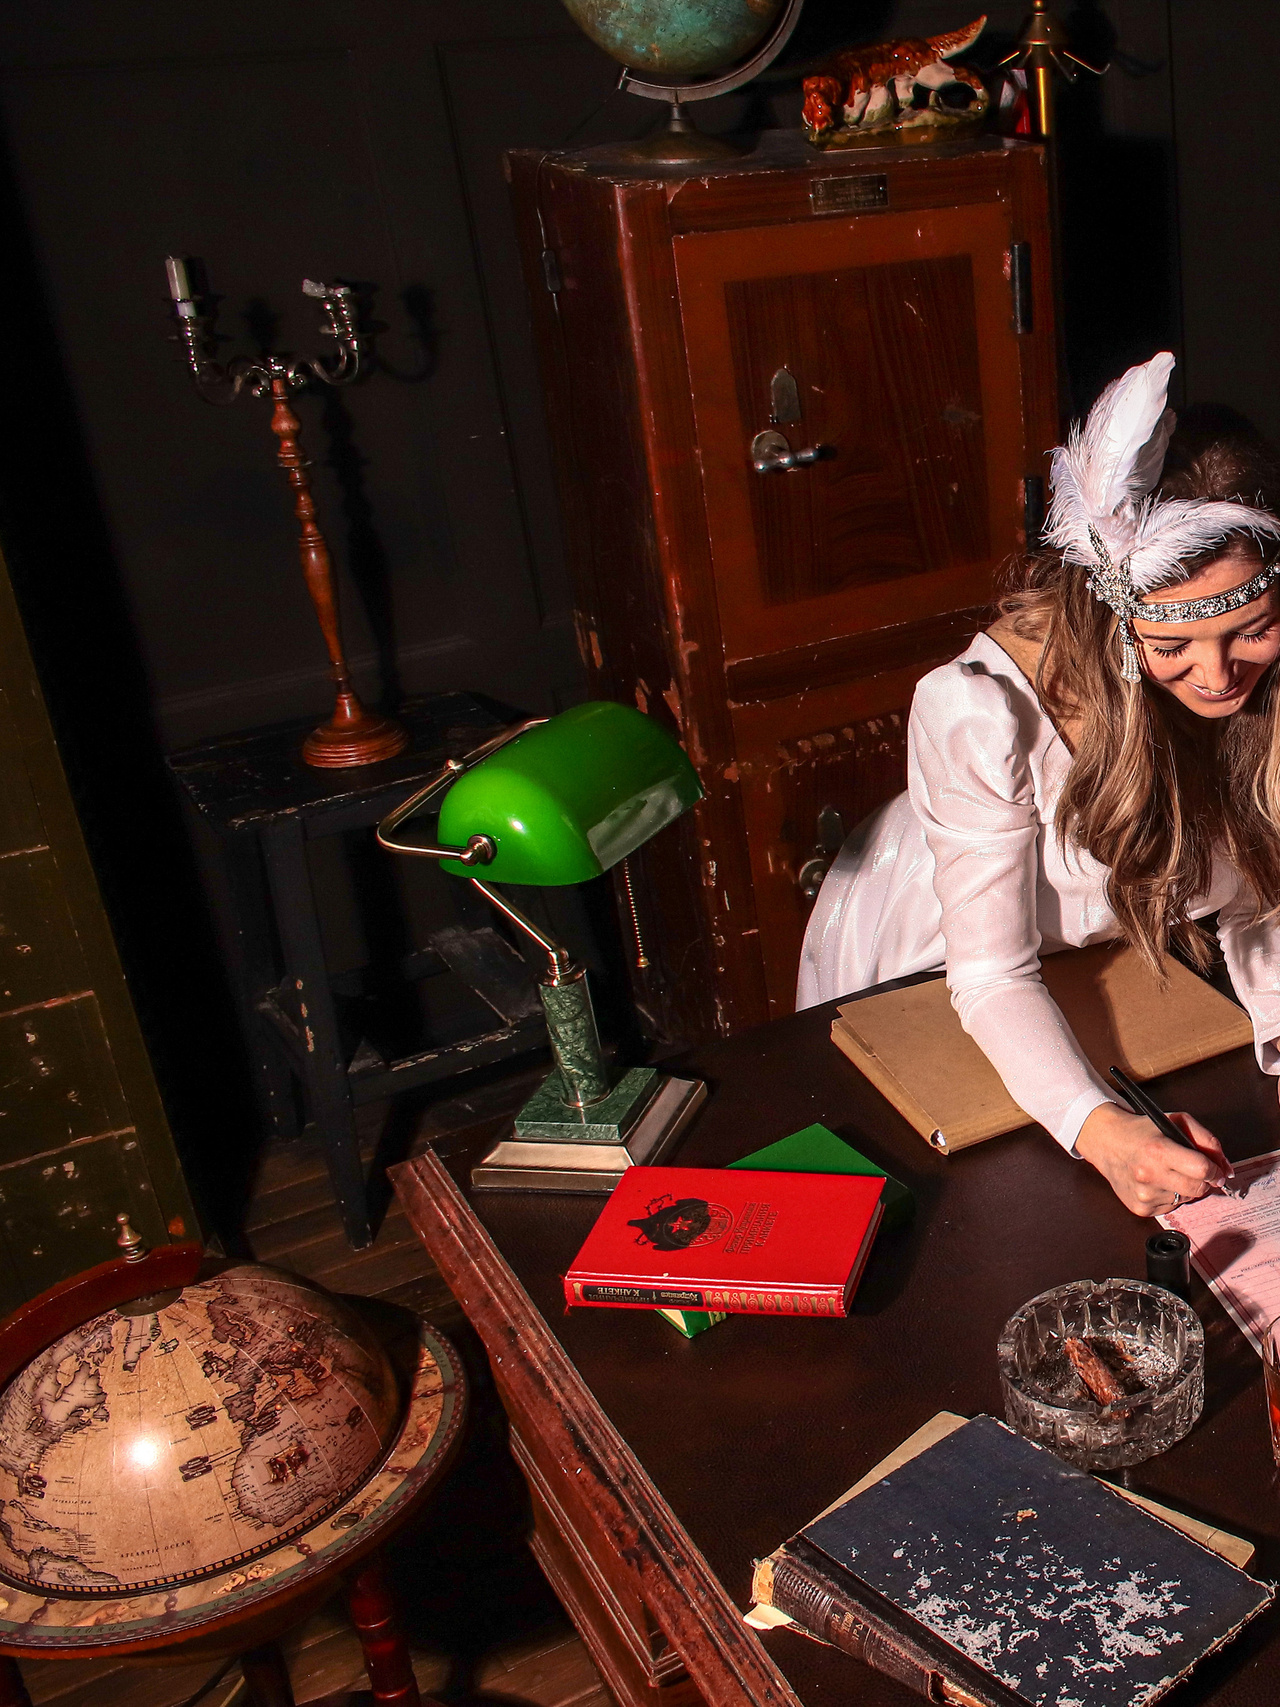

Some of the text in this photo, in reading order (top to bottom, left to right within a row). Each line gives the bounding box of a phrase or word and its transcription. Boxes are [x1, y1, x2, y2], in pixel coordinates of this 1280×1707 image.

[739, 1202, 771, 1254] ПРИМЕЧАНИЯ
[587, 1293, 650, 1303] ПРИМЕЧАНИЯ
[596, 1286, 640, 1297] К АНКЕТЕ
[344, 1501, 391, 1540] CANCER
[120, 1538, 192, 1559] ATLANTIC OCEAN
[212, 1577, 278, 1608] GEMINI
[62, 1623, 128, 1636] TAURUS
